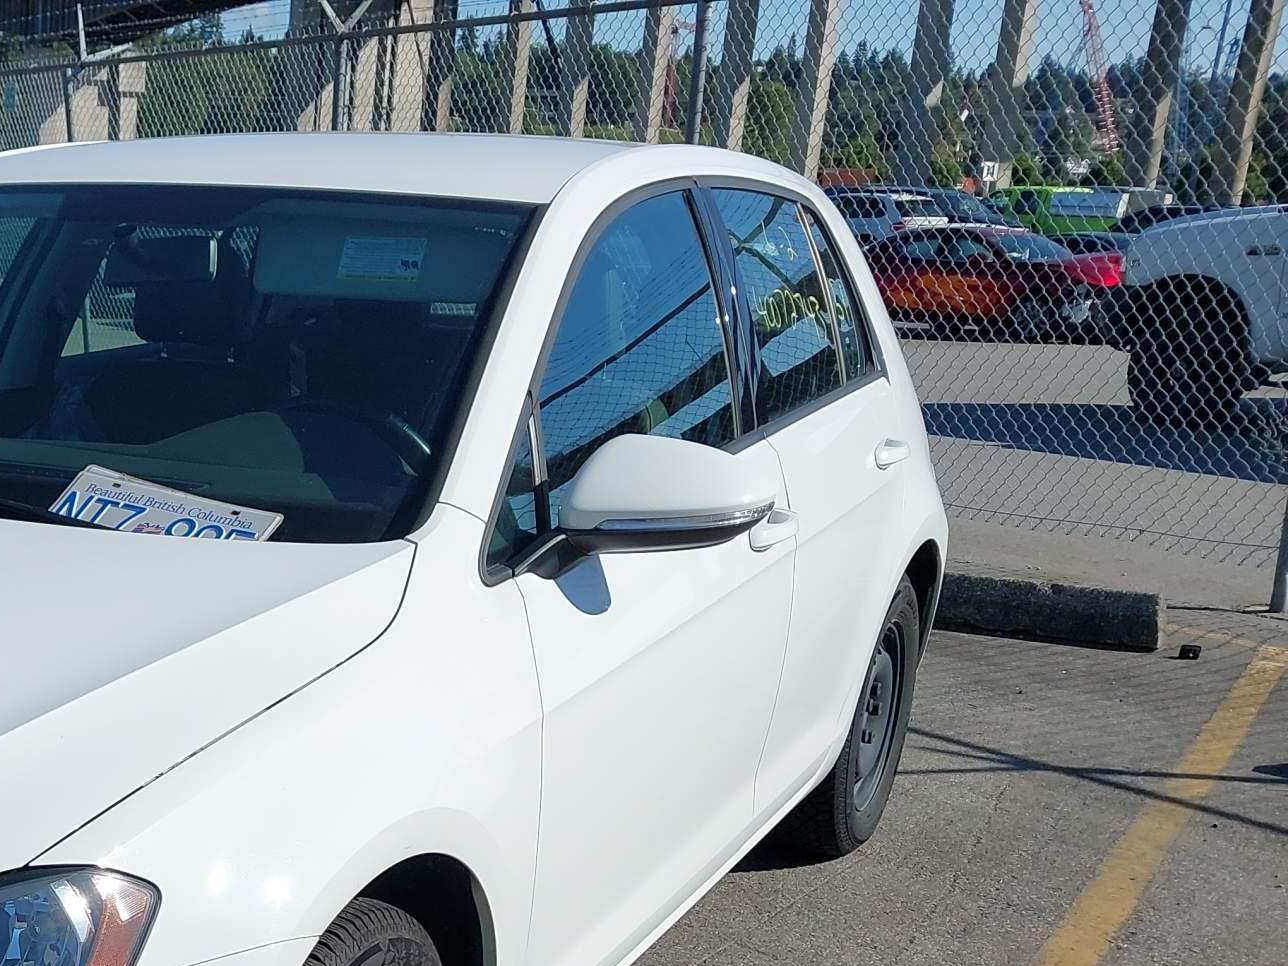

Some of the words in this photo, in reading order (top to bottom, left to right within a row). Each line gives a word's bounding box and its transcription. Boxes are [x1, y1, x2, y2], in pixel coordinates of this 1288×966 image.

[85, 483, 144, 505] Beautiful
[144, 496, 186, 515] British
[187, 507, 253, 530] Columbia
